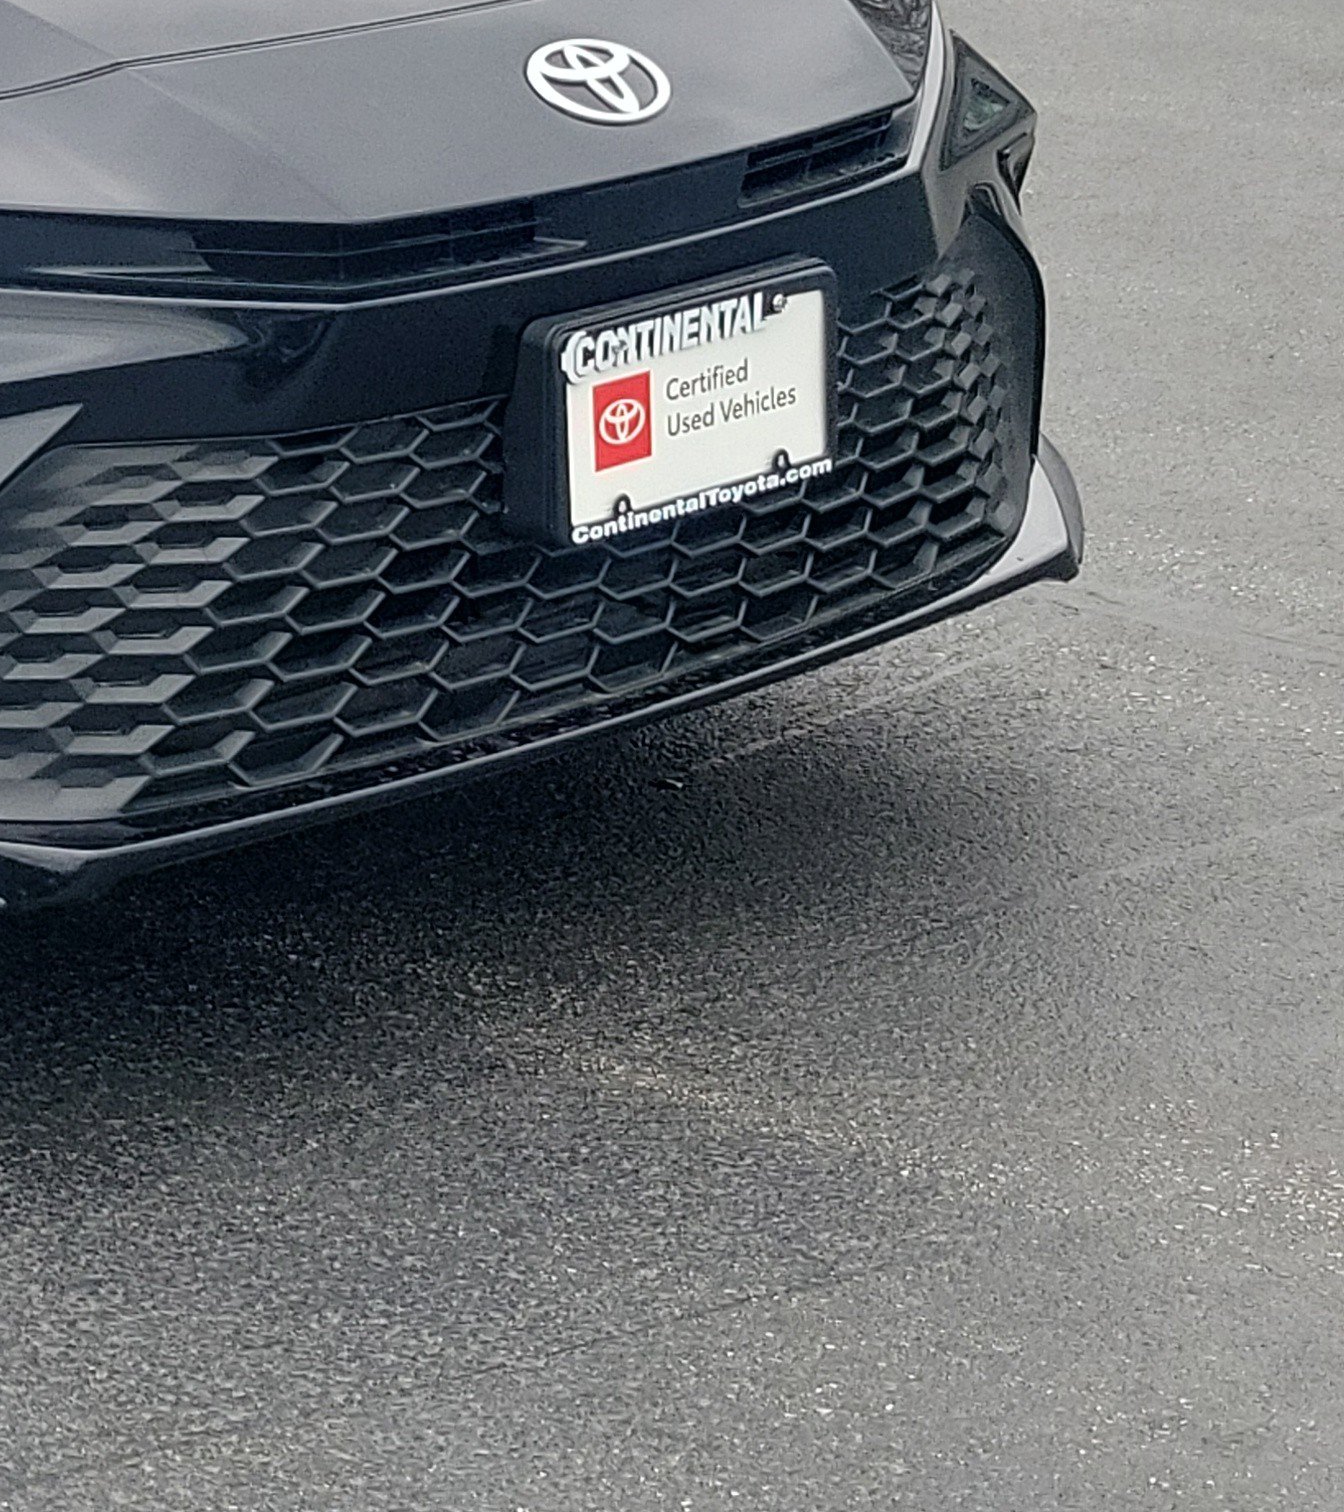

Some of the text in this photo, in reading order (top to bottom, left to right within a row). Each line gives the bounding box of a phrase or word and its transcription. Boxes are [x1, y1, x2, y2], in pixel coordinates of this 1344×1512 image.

[561, 292, 767, 384] CONTINENTAL
[666, 357, 748, 400] Certified
[667, 386, 796, 437] Used Vehicles
[571, 458, 833, 545] ContinentalToyota.com
